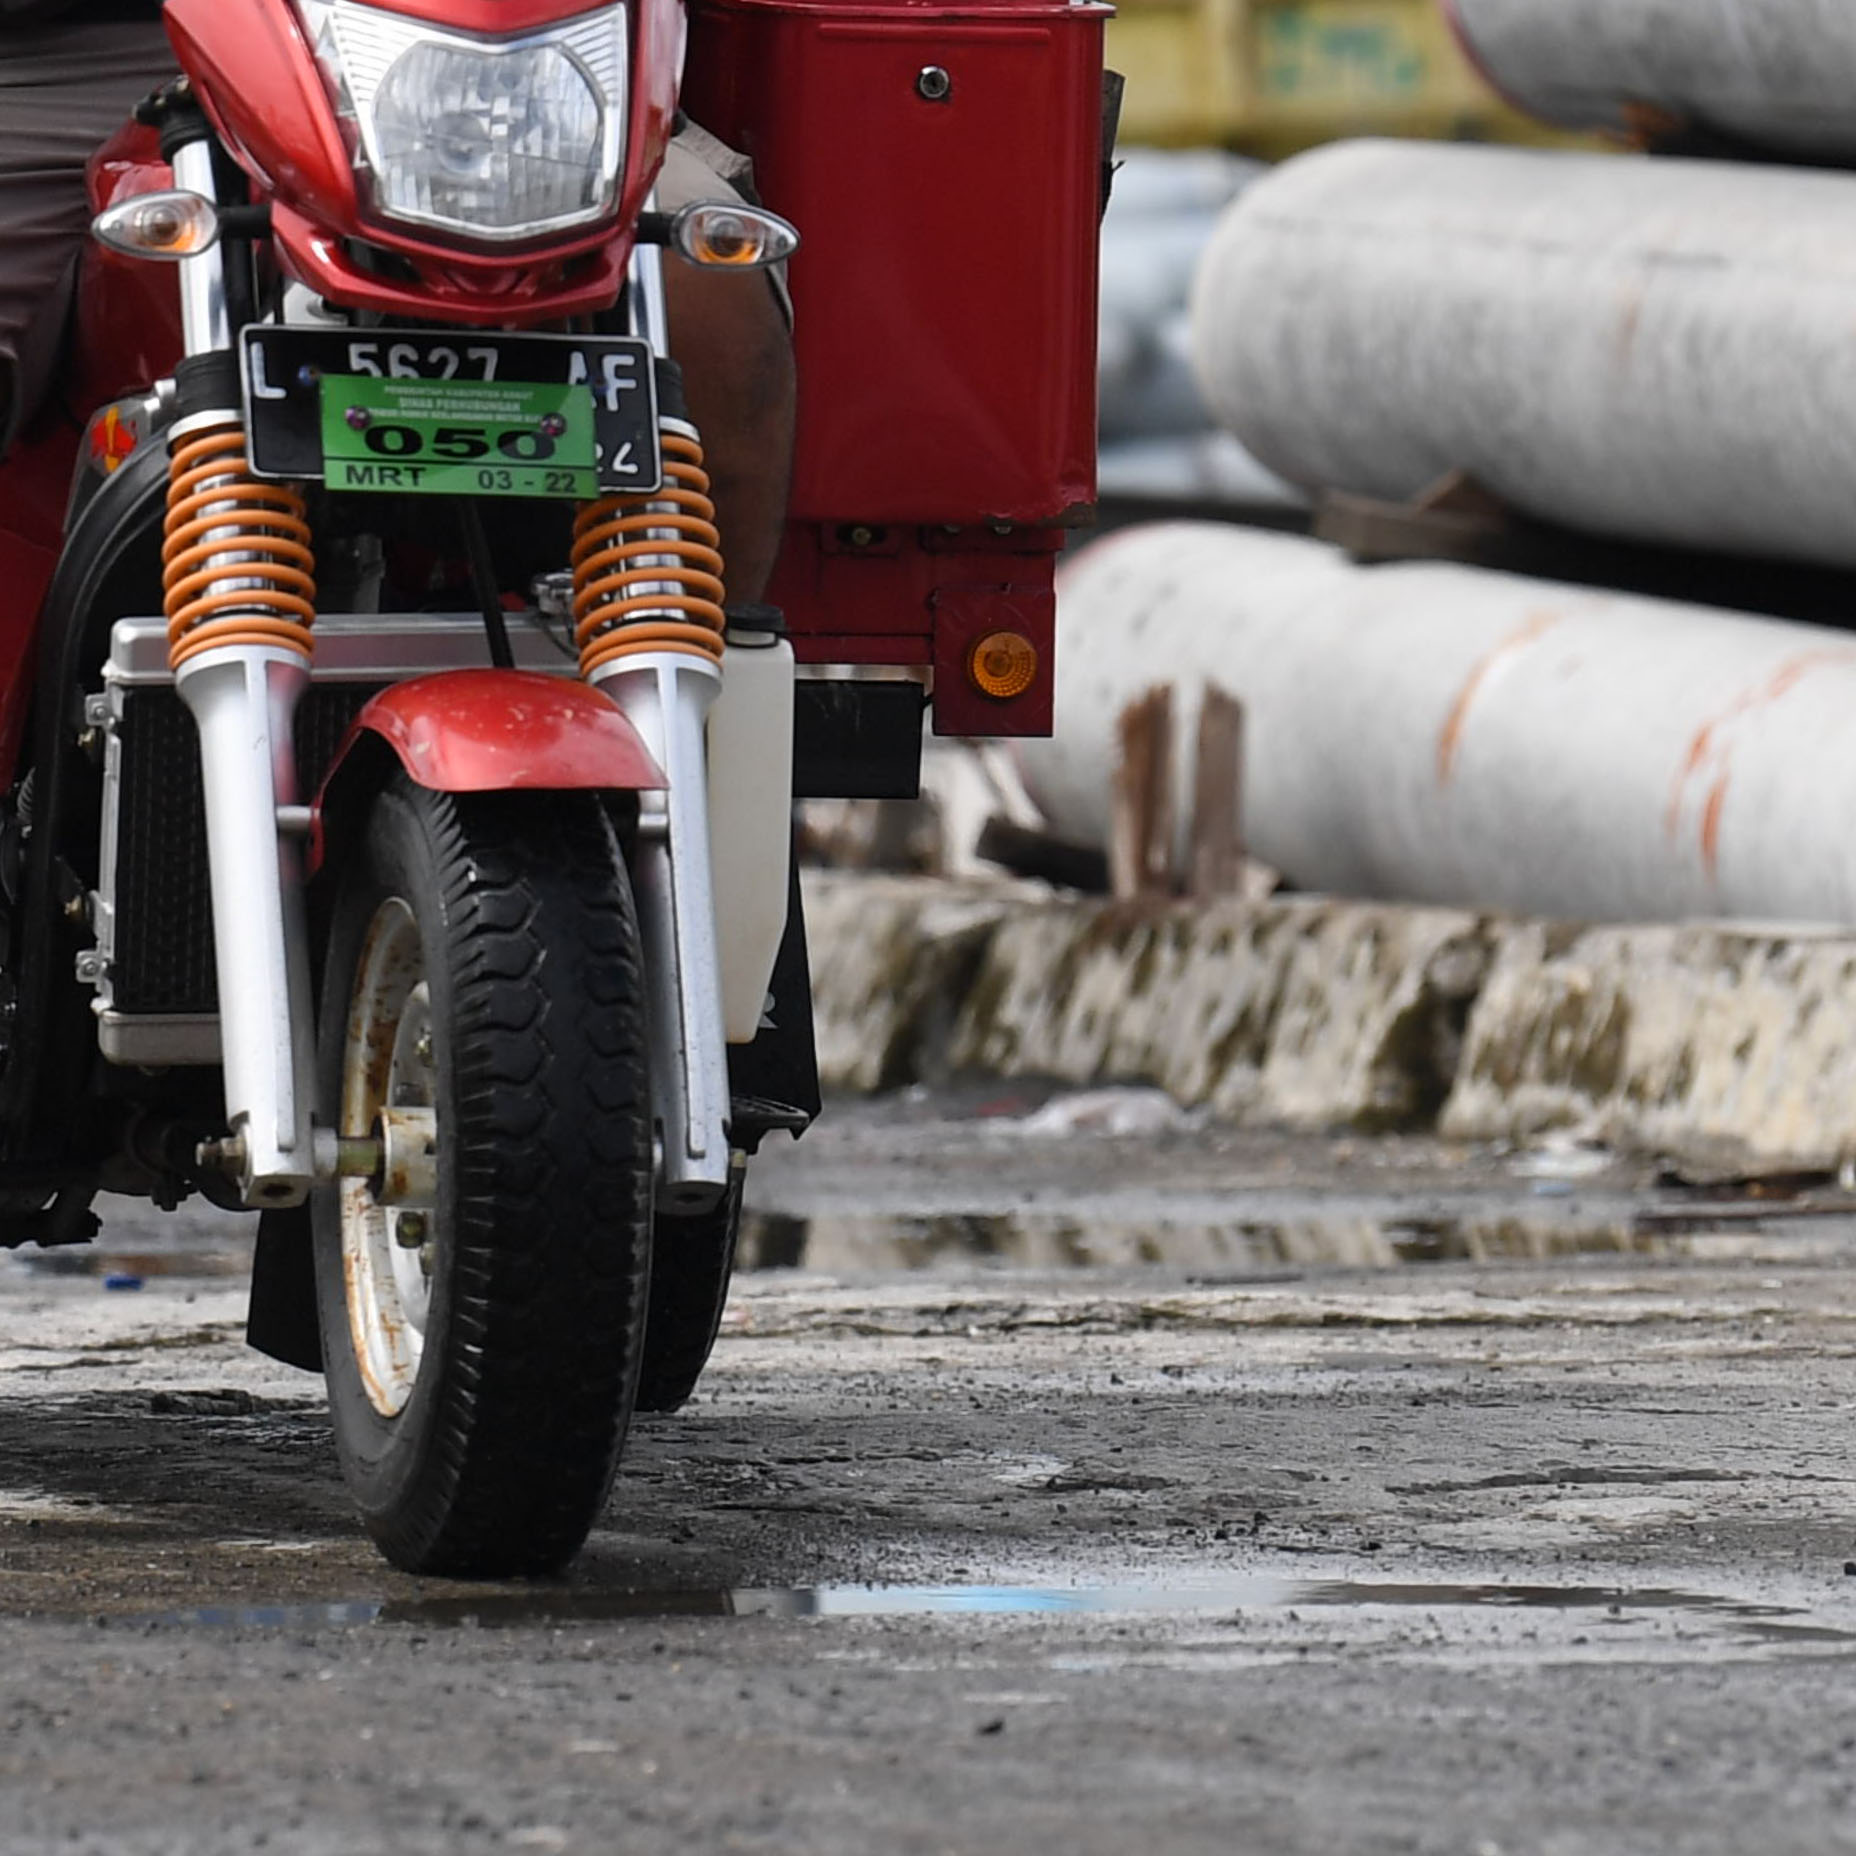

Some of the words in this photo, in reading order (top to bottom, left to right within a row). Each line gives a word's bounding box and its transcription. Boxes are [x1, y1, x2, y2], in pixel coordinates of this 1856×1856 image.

[251, 342, 286, 399] L
[347, 344, 499, 382] 5627
[365, 425, 556, 460] 050
[346, 464, 427, 487] MRT
[478, 470, 512, 490] 03
[544, 472, 577, 493] 22
